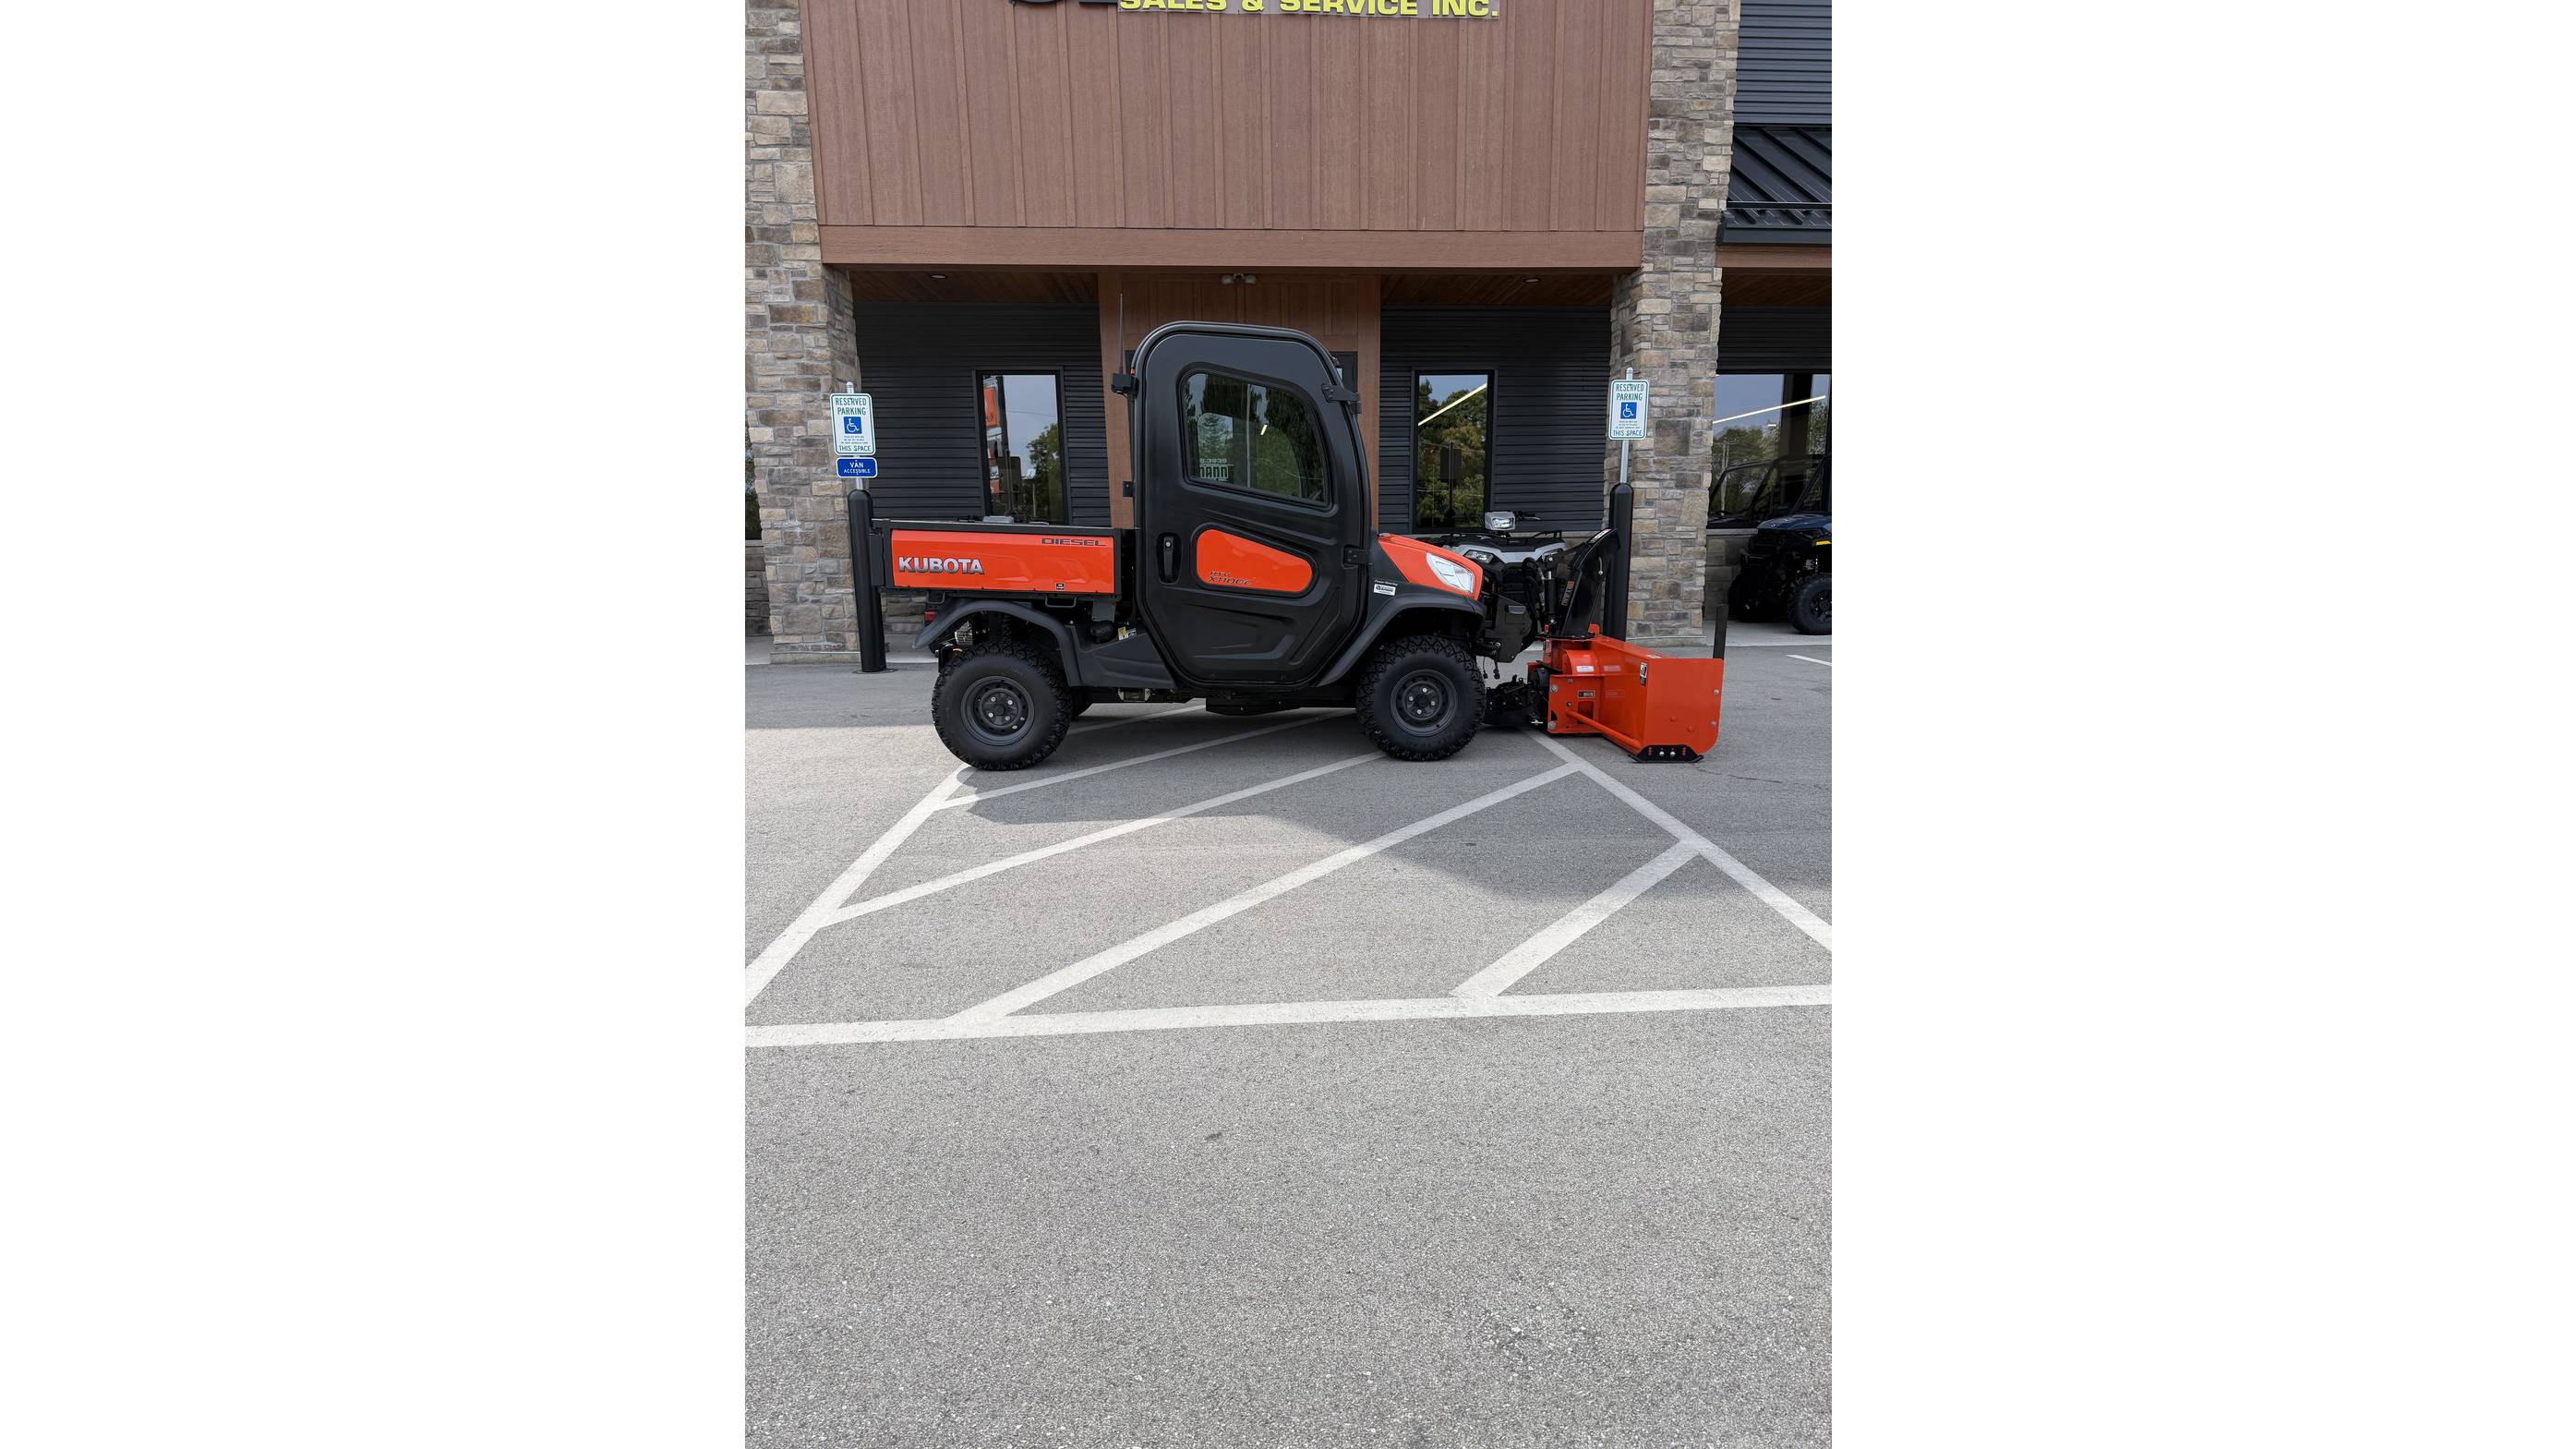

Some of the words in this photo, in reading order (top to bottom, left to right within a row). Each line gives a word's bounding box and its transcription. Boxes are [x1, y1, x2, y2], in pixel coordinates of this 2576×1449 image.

[1119, 0, 1226, 10] SALES
[1242, 0, 1264, 11] &
[1280, 0, 1418, 16] SERVICE
[1432, 0, 1499, 17] INC.
[835, 397, 867, 405] RESERVED
[1041, 537, 1106, 547] DIESEL
[898, 556, 985, 574] KUBOTA
